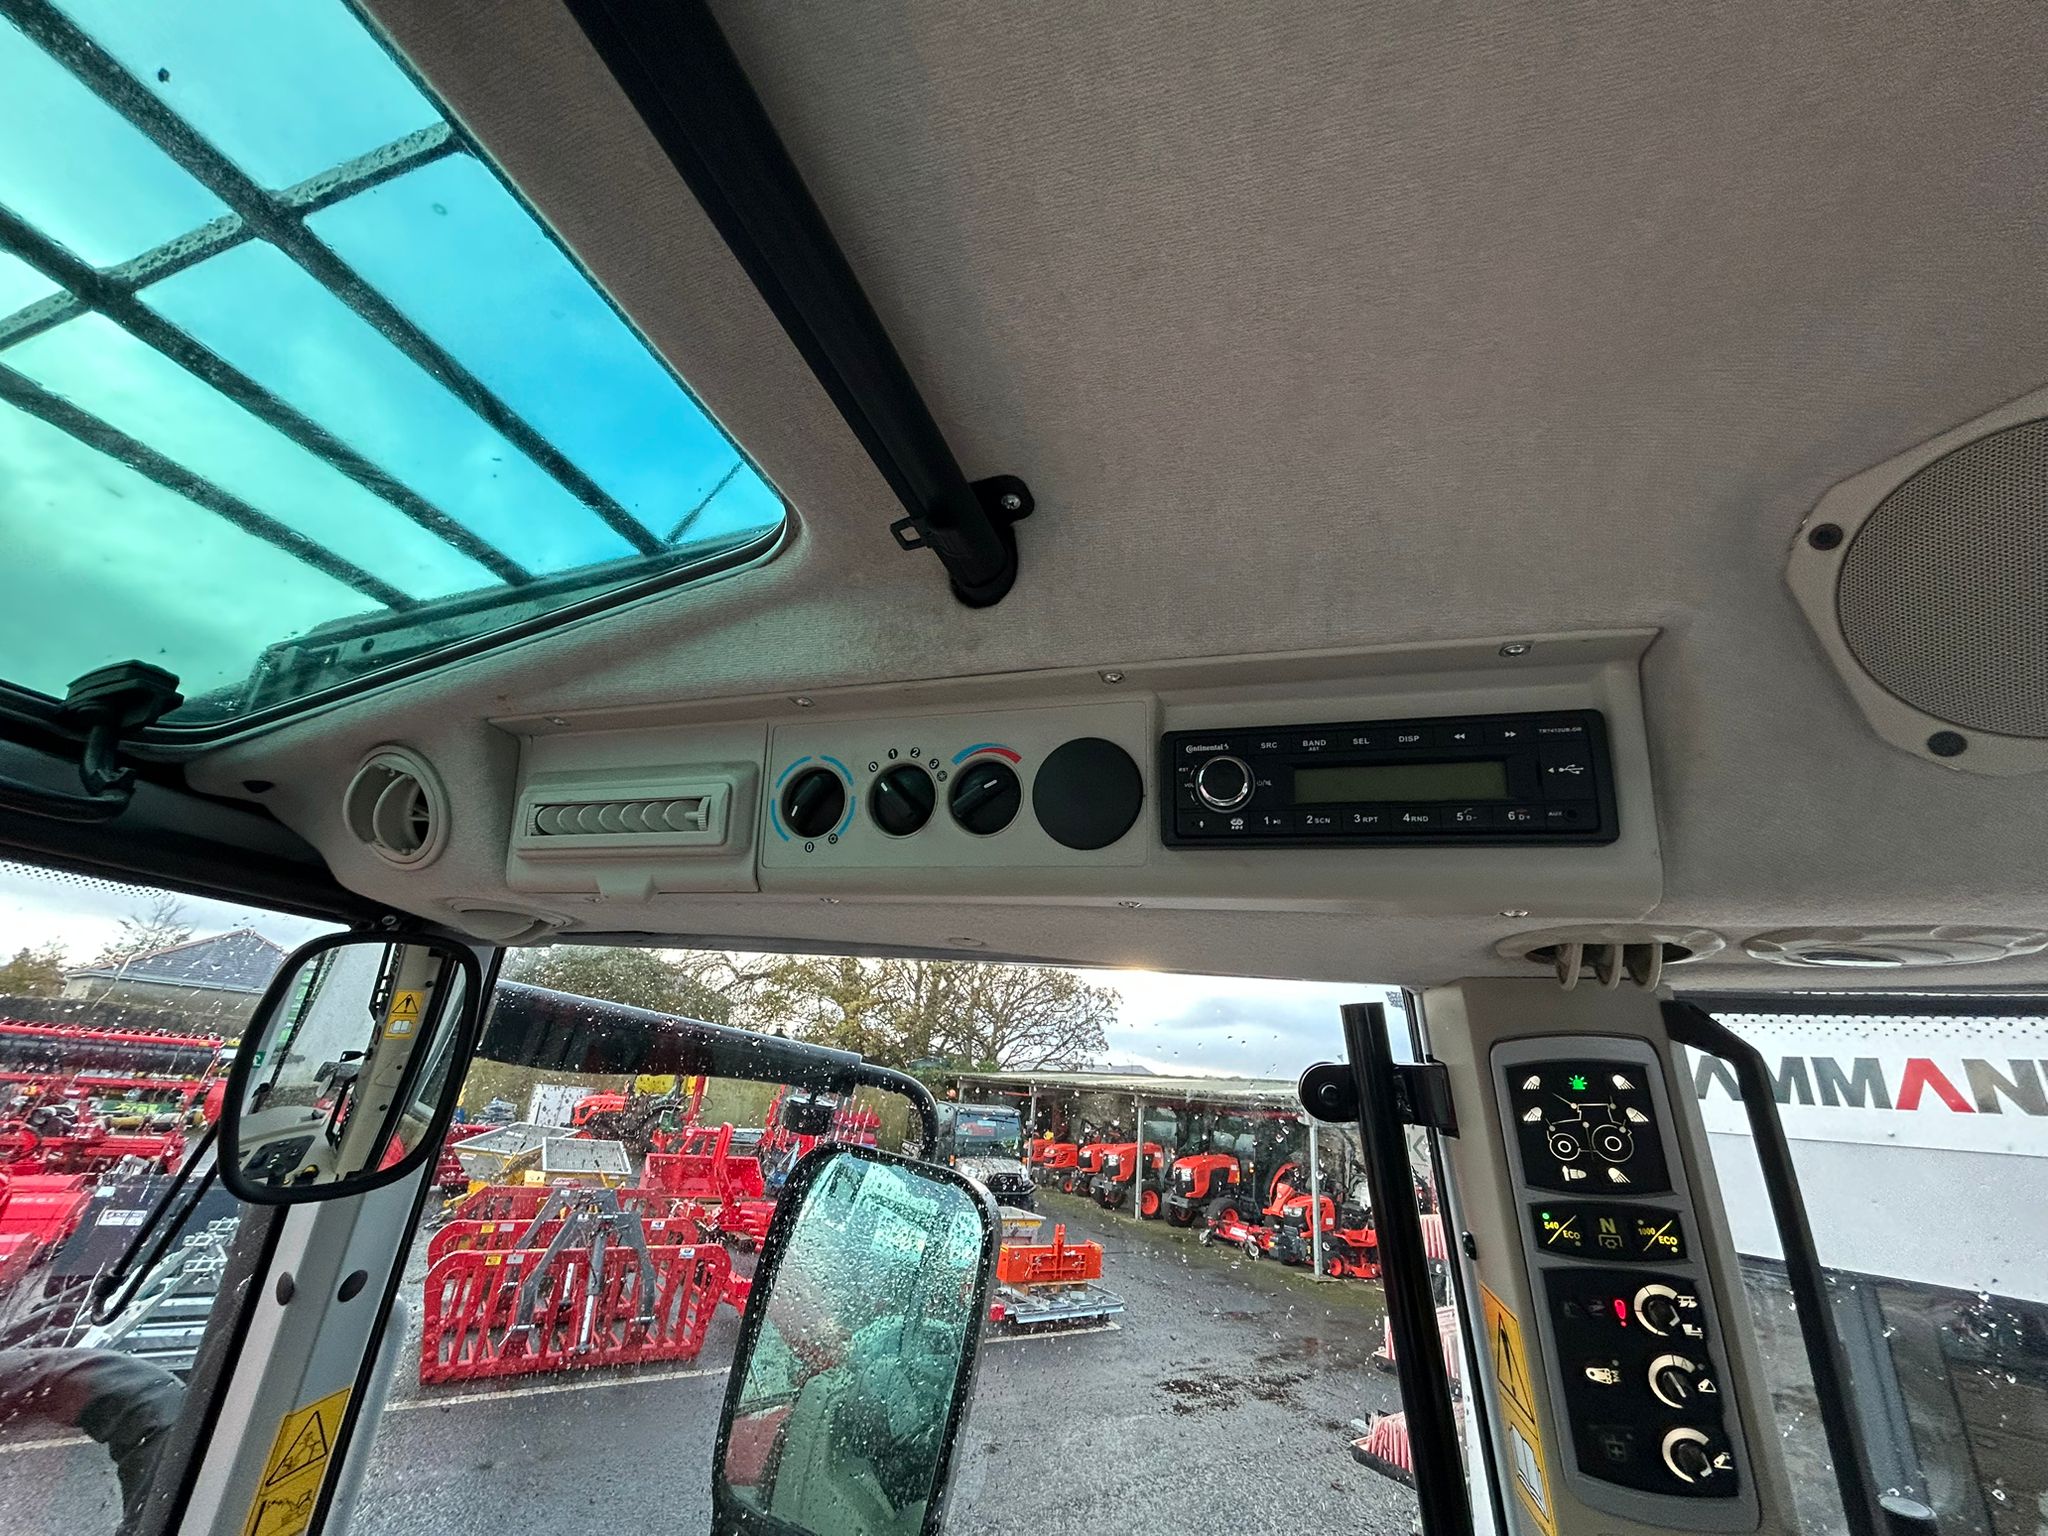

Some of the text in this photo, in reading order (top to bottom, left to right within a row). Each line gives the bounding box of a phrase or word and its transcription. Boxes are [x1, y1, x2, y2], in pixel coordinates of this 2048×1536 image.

[1302, 739, 1327, 747] BAND
[1353, 737, 1370, 745] SEL
[911, 748, 919, 757] 2
[1185, 744, 1223, 753] Continental
[1263, 816, 1269, 824] 1
[1306, 815, 1313, 824] 2
[1354, 814, 1361, 823] 3
[1402, 813, 1410, 822] 4
[1456, 812, 1464, 821] 5
[1507, 811, 1516, 820] 6
[1694, 1046, 2048, 1116] AMMAN
[1544, 1221, 1560, 1230] 540
[1599, 1217, 1617, 1234] N
[1562, 1229, 1581, 1240] ECO
[1638, 1227, 1656, 1236] 1000
[1658, 1235, 1678, 1246] ECO
